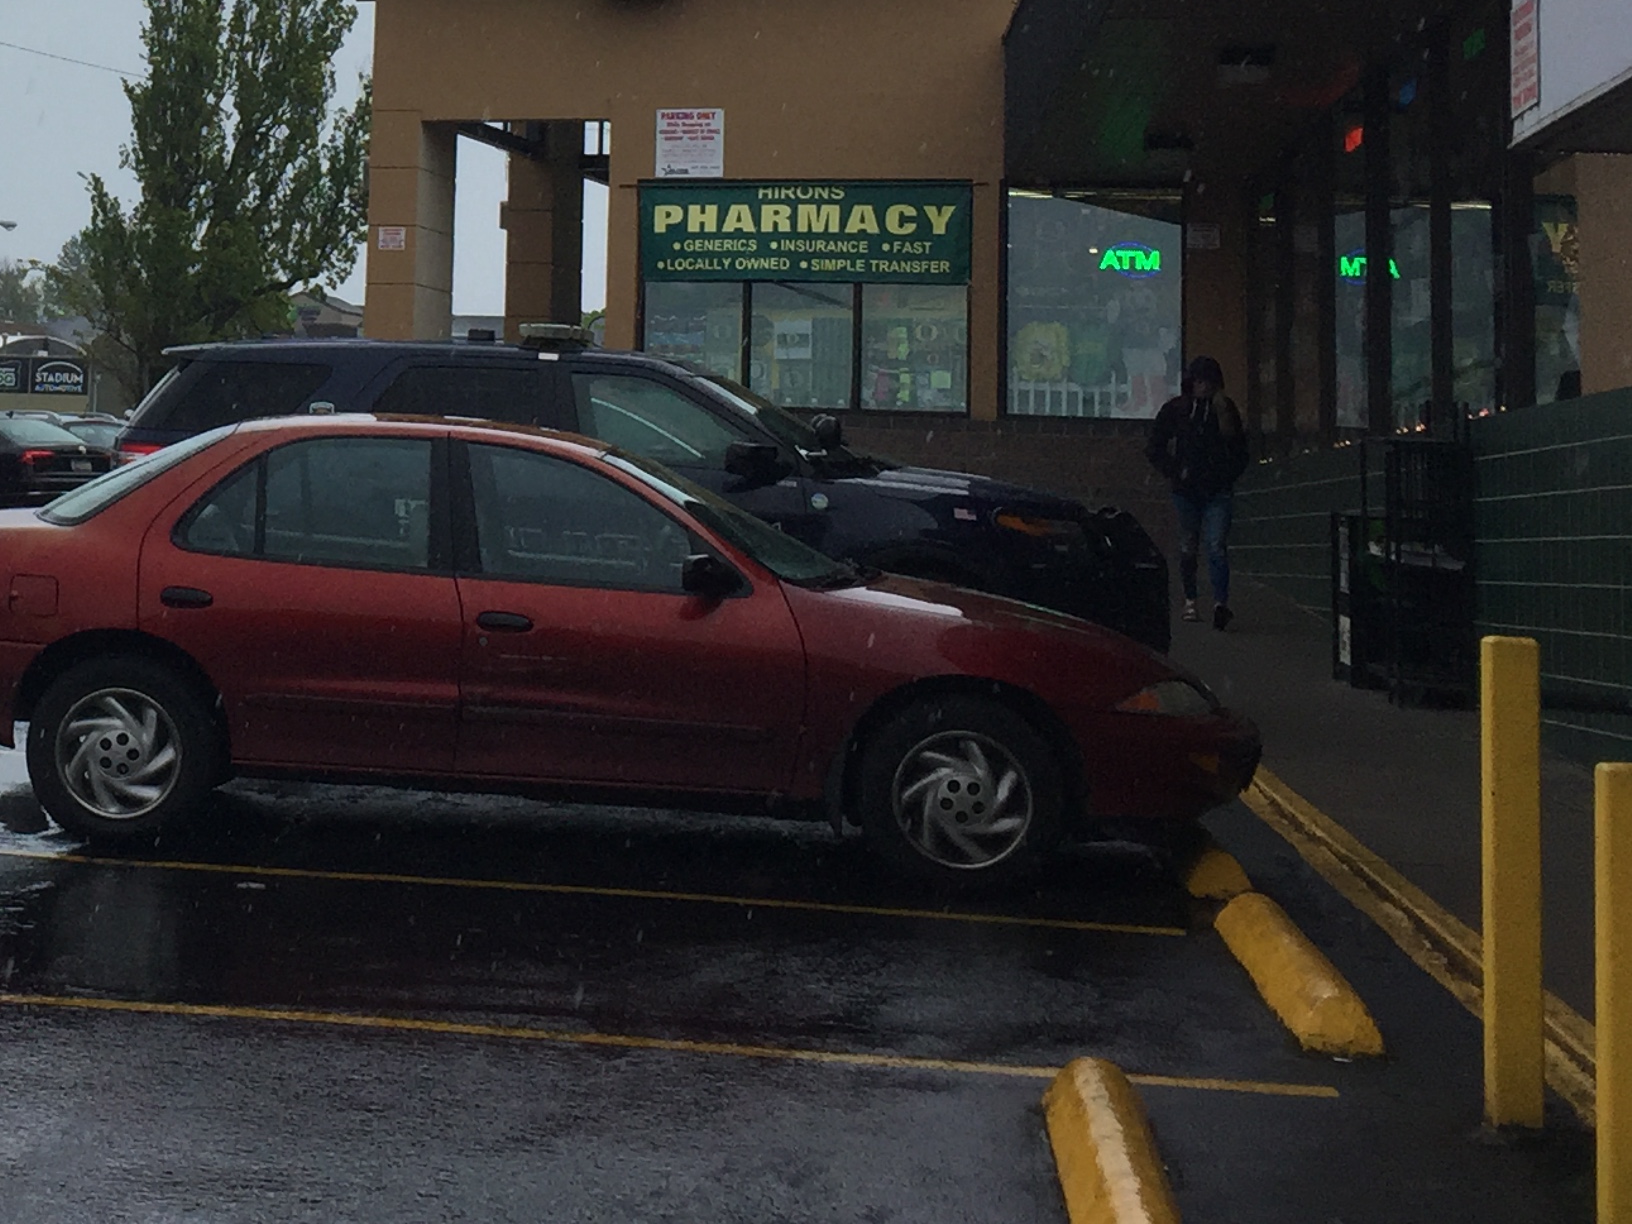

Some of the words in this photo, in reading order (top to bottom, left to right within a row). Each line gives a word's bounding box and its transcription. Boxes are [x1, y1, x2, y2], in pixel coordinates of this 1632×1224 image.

[758, 186, 845, 200] HIRONS
[653, 204, 957, 235] PHARMACY
[683, 239, 758, 252] GENERICS
[780, 239, 868, 253] INSURANCE
[893, 241, 933, 254] FAST
[667, 258, 731, 271] LOCALLY
[735, 257, 790, 270] OWNED
[810, 258, 866, 272] SIMPLE
[869, 260, 951, 274] TRANSFER
[1099, 249, 1161, 271] ATM
[35, 372, 84, 384] STADIUM
